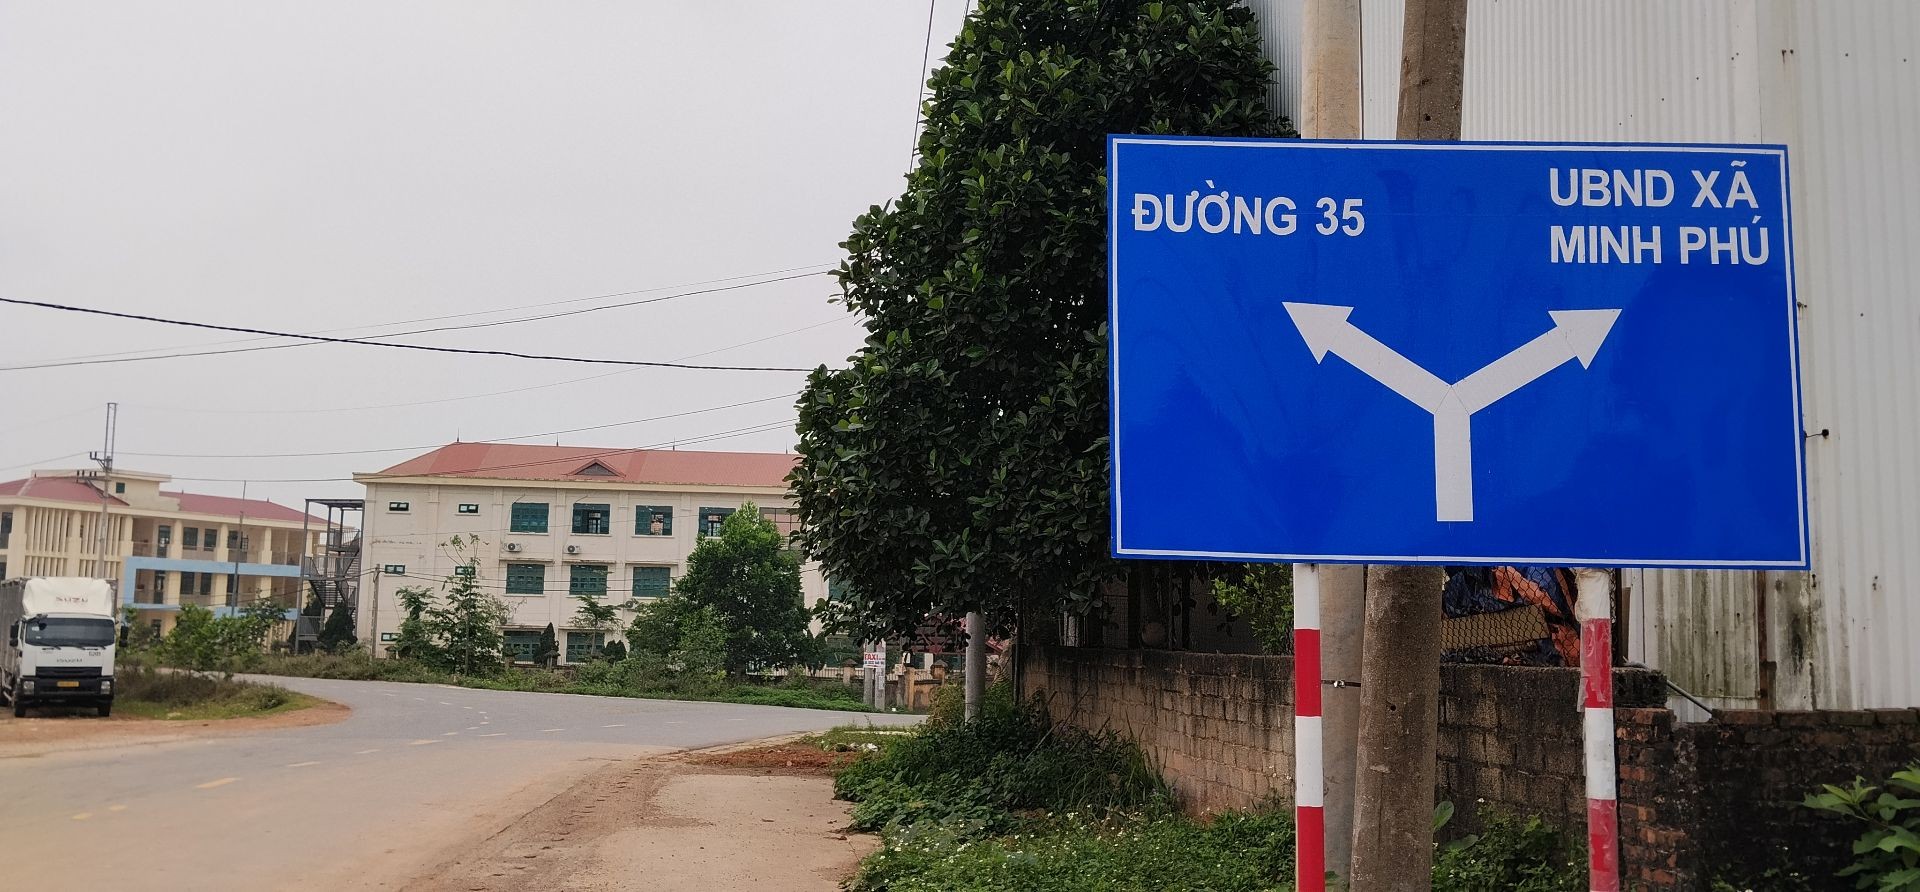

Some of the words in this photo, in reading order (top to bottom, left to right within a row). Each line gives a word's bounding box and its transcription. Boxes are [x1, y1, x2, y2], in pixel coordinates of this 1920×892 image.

[1131, 179, 1297, 236] ĐƯỜNG
[1315, 196, 1365, 237] 35
[1549, 167, 1675, 208] UBND
[1691, 160, 1759, 209] XÃ
[1550, 225, 1662, 264] MINH
[1679, 215, 1769, 266] PHÚ
